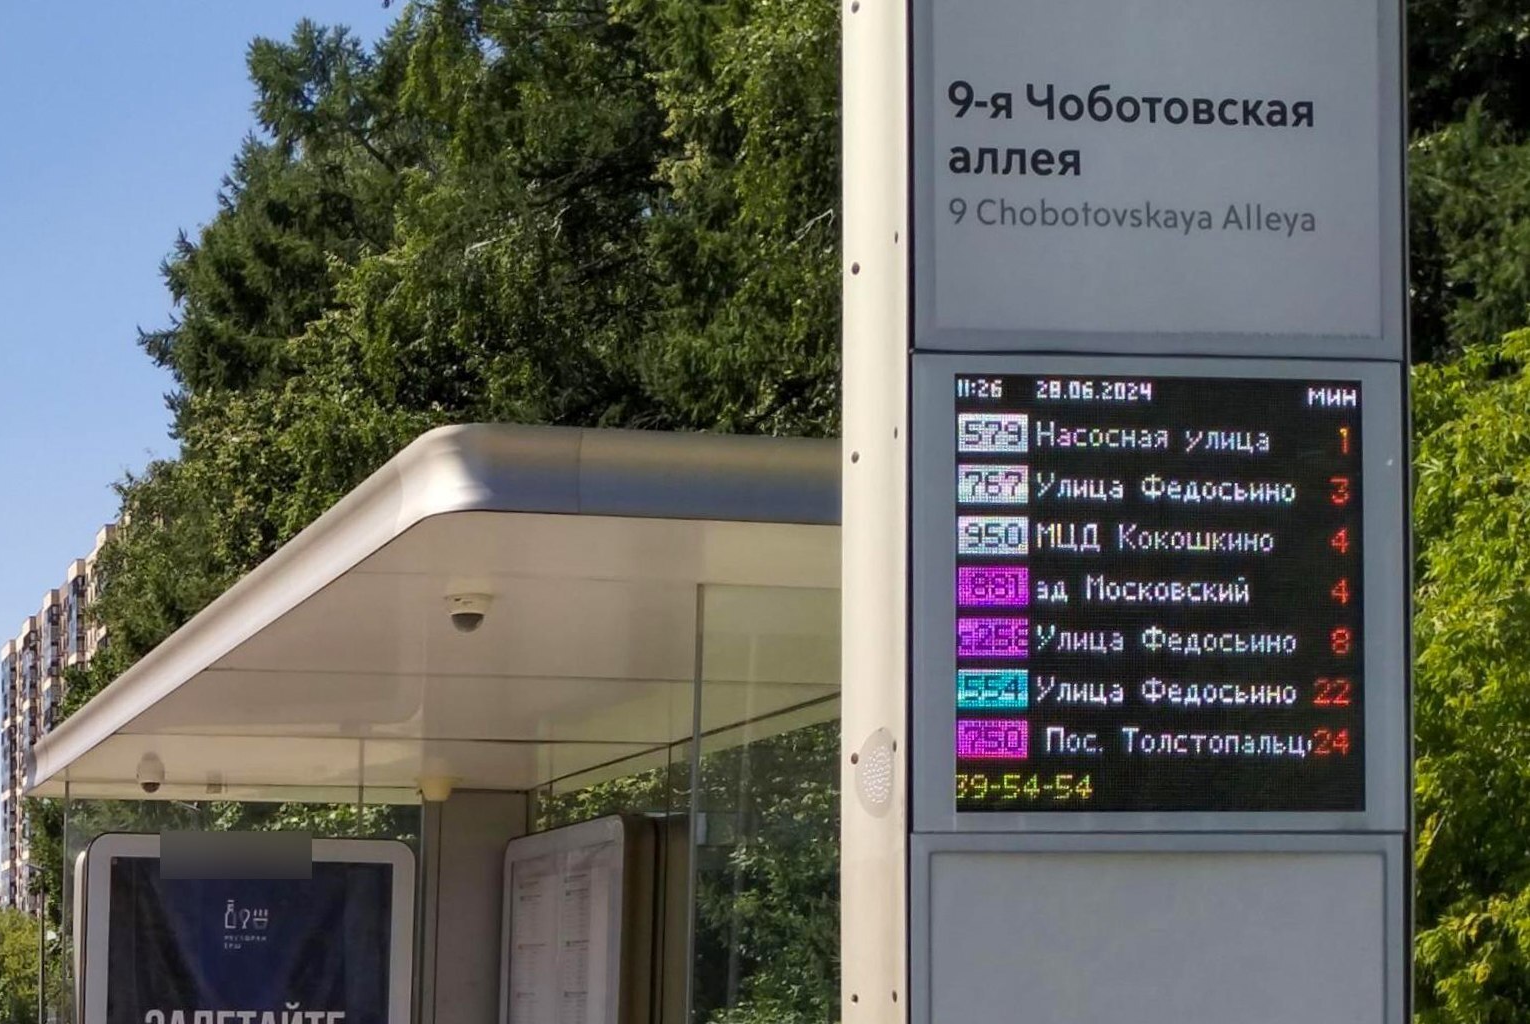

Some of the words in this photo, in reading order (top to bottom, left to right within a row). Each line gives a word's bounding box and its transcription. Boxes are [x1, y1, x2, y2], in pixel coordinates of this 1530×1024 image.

[948, 80, 1013, 119] 9-я
[1026, 83, 1315, 128] Чоботовская
[948, 145, 1082, 176] аллея
[948, 198, 967, 226] 9
[976, 198, 1213, 237] Chobotovskaya
[1222, 204, 1316, 239] Alleya
[957, 379, 1003, 398] 11:26
[1035, 380, 1152, 400] 28.06.2024
[963, 419, 1023, 446] 579
[1035, 421, 1168, 448] Насосная
[1185, 430, 1270, 454] улица
[1339, 428, 1350, 454] 1
[963, 470, 1023, 498] 767
[1036, 473, 1124, 502] Улица
[1140, 473, 1297, 503] Федосьино
[1330, 478, 1350, 505] 3
[963, 522, 1023, 549] 950
[1036, 523, 1101, 553] МЦД
[1118, 524, 1274, 553] Кокошкино
[1330, 528, 1350, 554] 4
[1086, 573, 1250, 604] Московский
[1330, 579, 1350, 606] 4
[1036, 625, 1124, 656] Улица
[1140, 625, 1298, 656] Федосьино
[1330, 629, 1350, 656] 8
[962, 675, 1021, 703] 554
[1036, 677, 1124, 706] Улица
[1140, 676, 1298, 706] Федосьино
[1313, 678, 1351, 706] 22
[962, 726, 1022, 752] 750
[1046, 726, 1104, 754] Пос.
[1122, 726, 1311, 758] Толстопальц
[1313, 728, 1351, 757] 24
